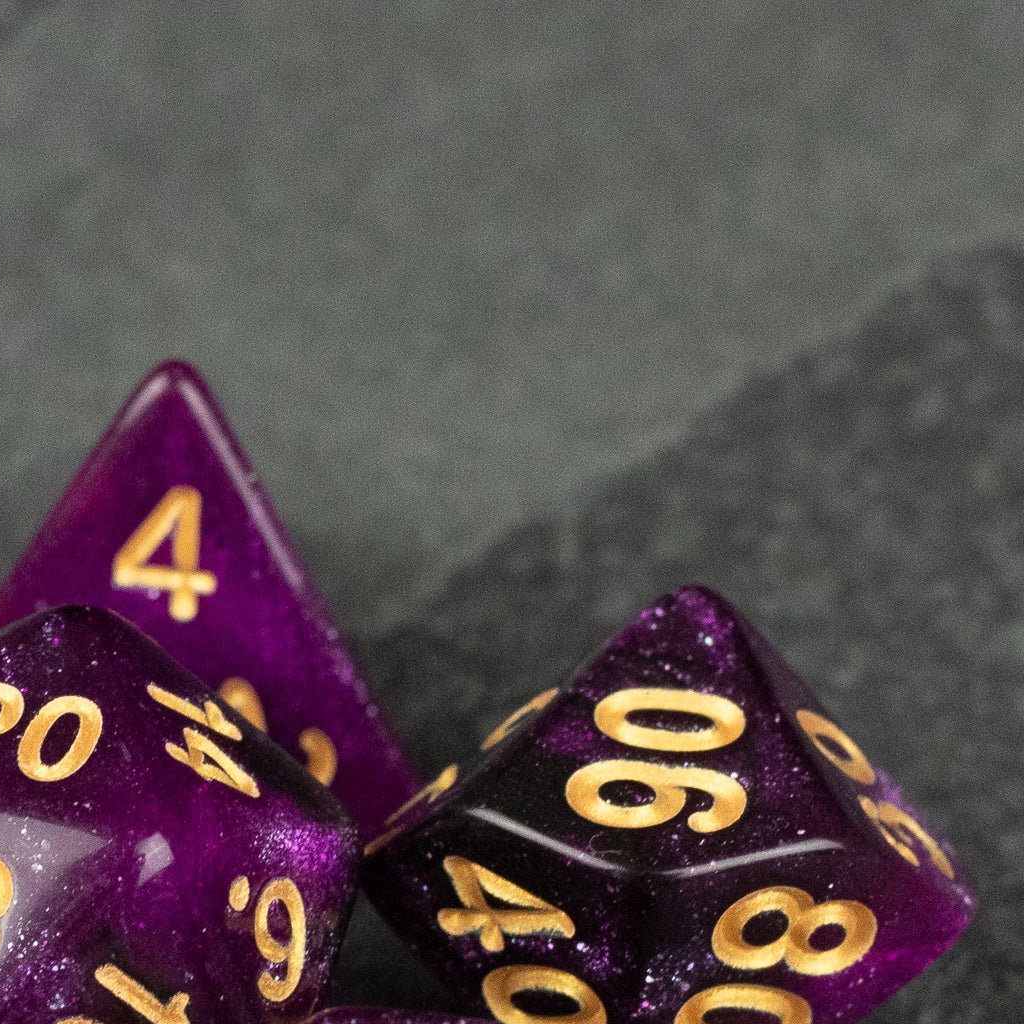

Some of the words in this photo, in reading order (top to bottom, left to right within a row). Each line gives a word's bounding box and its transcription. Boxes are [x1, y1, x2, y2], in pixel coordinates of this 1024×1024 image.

[112, 486, 217, 622] 4
[147, 681, 261, 798] 14
[564, 686, 749, 835] 90
